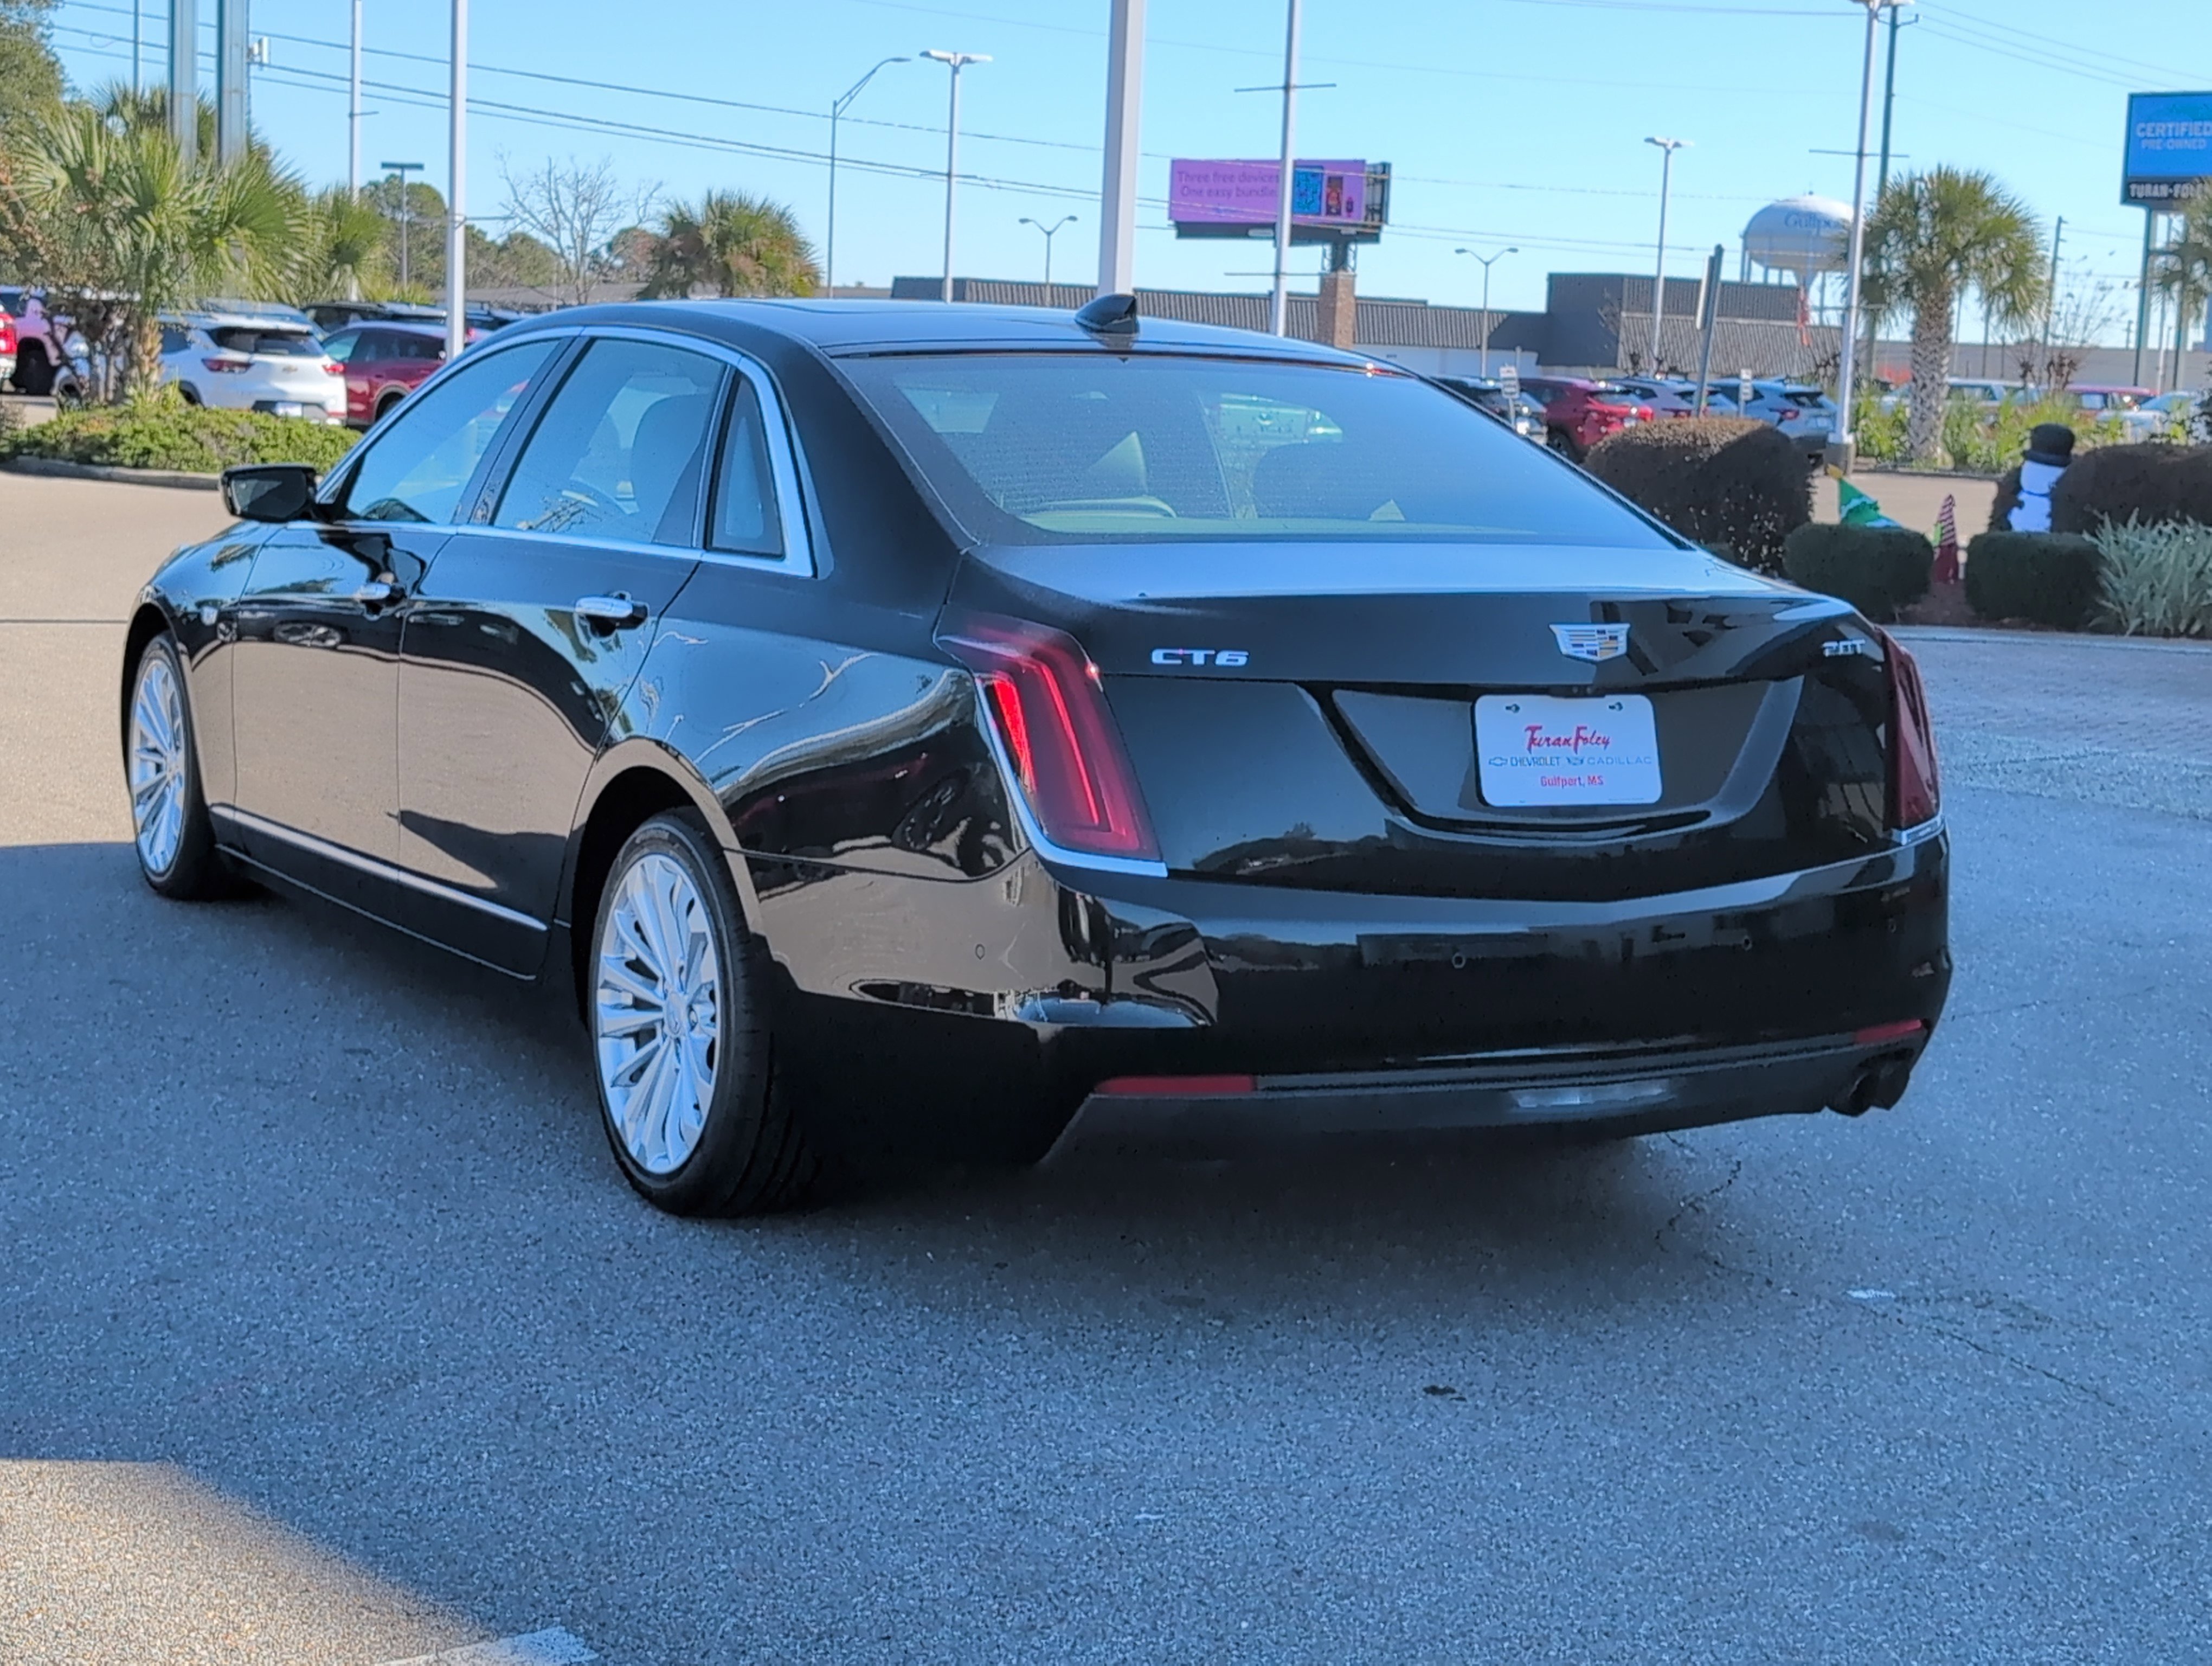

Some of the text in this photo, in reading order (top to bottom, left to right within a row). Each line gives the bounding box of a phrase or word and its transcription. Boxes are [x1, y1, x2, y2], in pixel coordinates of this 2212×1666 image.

[2136, 121, 2212, 137] CERTIFIED
[1177, 171, 1210, 183] Three
[1213, 171, 1235, 183] free
[1181, 185, 1204, 196] One
[1207, 188, 1233, 200] easy
[1152, 649, 1249, 666] CT6
[1510, 756, 1652, 767] CHEVROLET CADILLAC
[1540, 775, 1604, 789] Gulfport, MS
